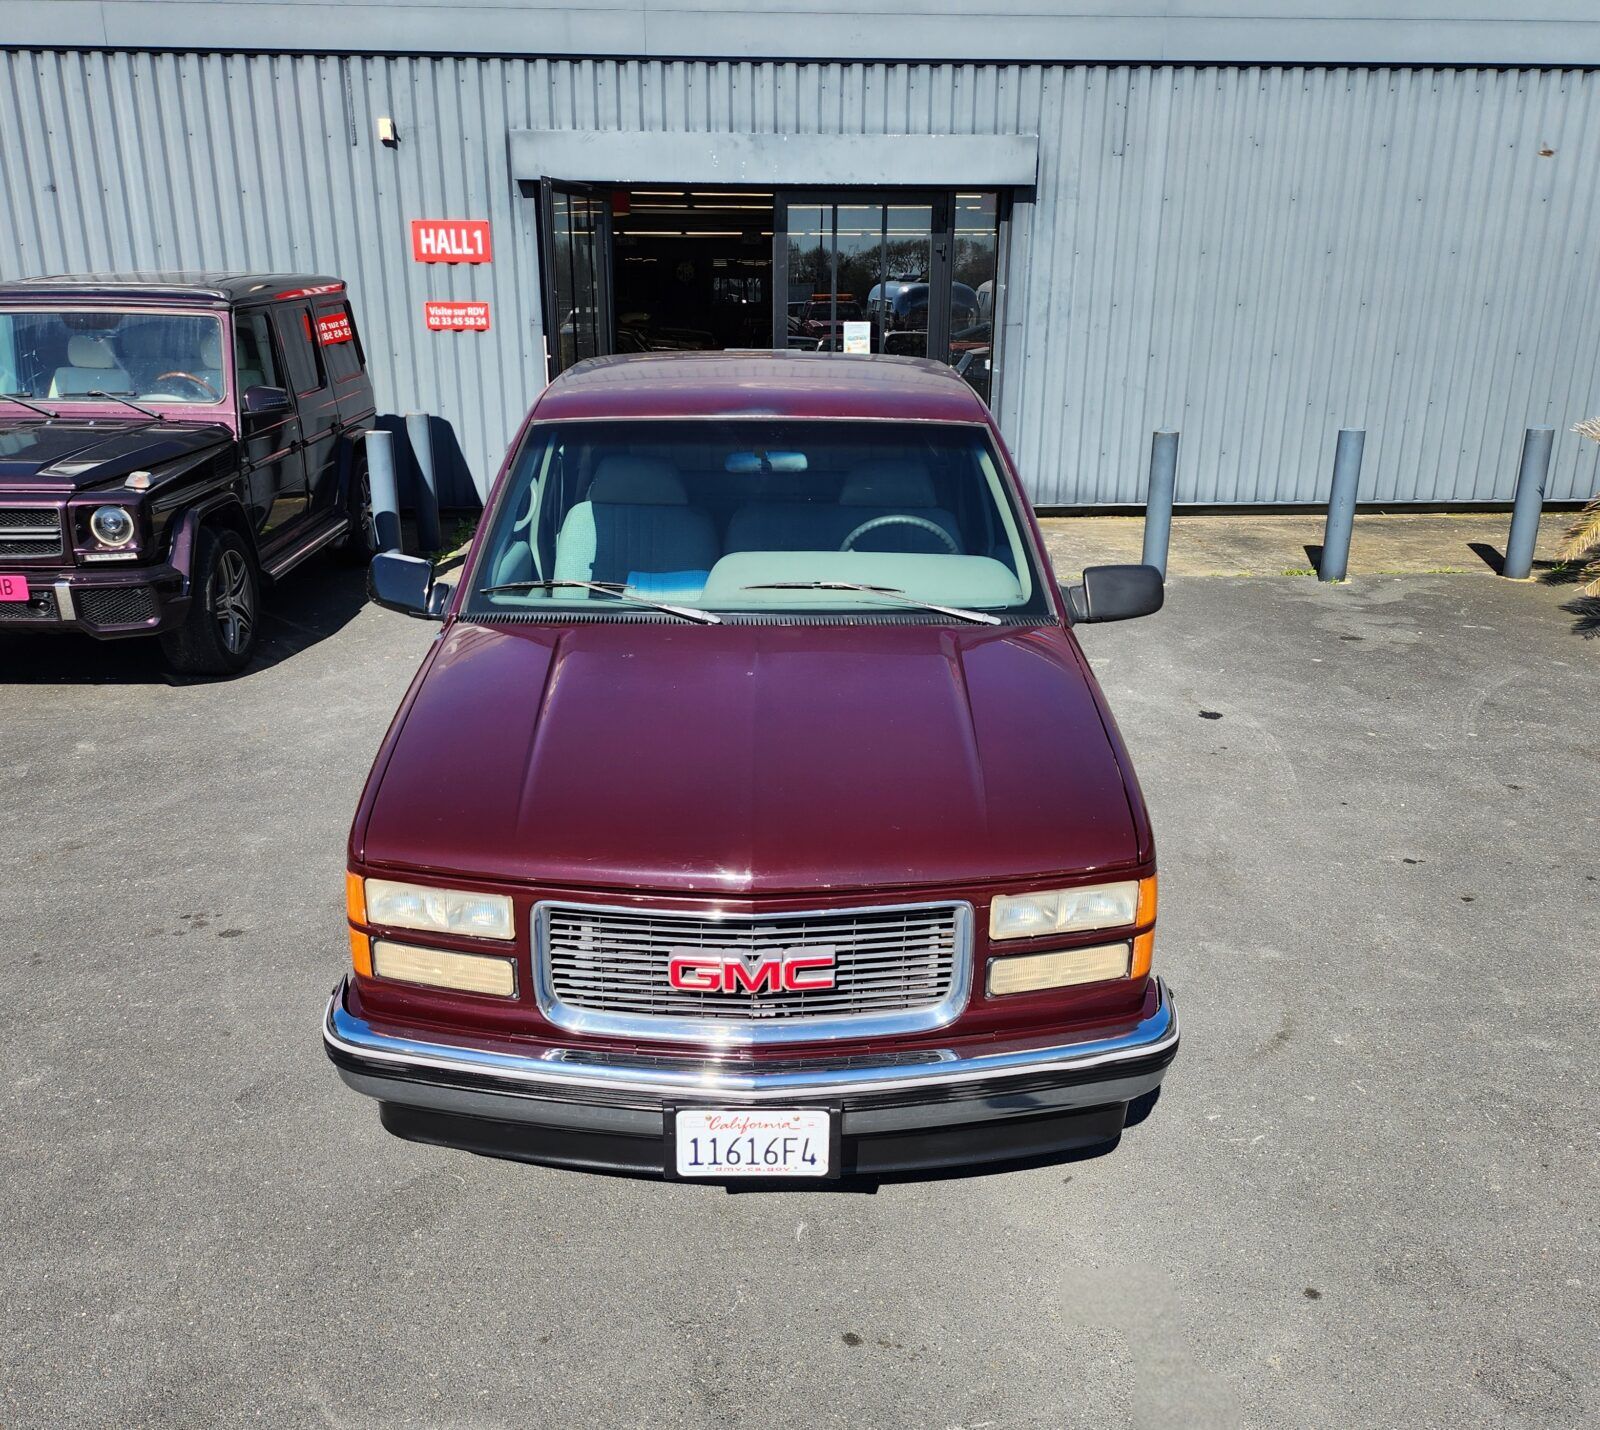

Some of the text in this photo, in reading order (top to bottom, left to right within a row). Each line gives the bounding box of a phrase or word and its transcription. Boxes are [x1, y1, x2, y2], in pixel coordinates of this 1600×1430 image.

[429, 306, 485, 316] Visite sur RDV
[429, 317, 441, 325] 02
[441, 317, 451, 325] 33
[452, 317, 463, 325] 45
[464, 317, 475, 325] 58
[668, 946, 836, 994] GMC
[708, 1115, 801, 1135] California
[688, 1136, 817, 1166] 11616F4
